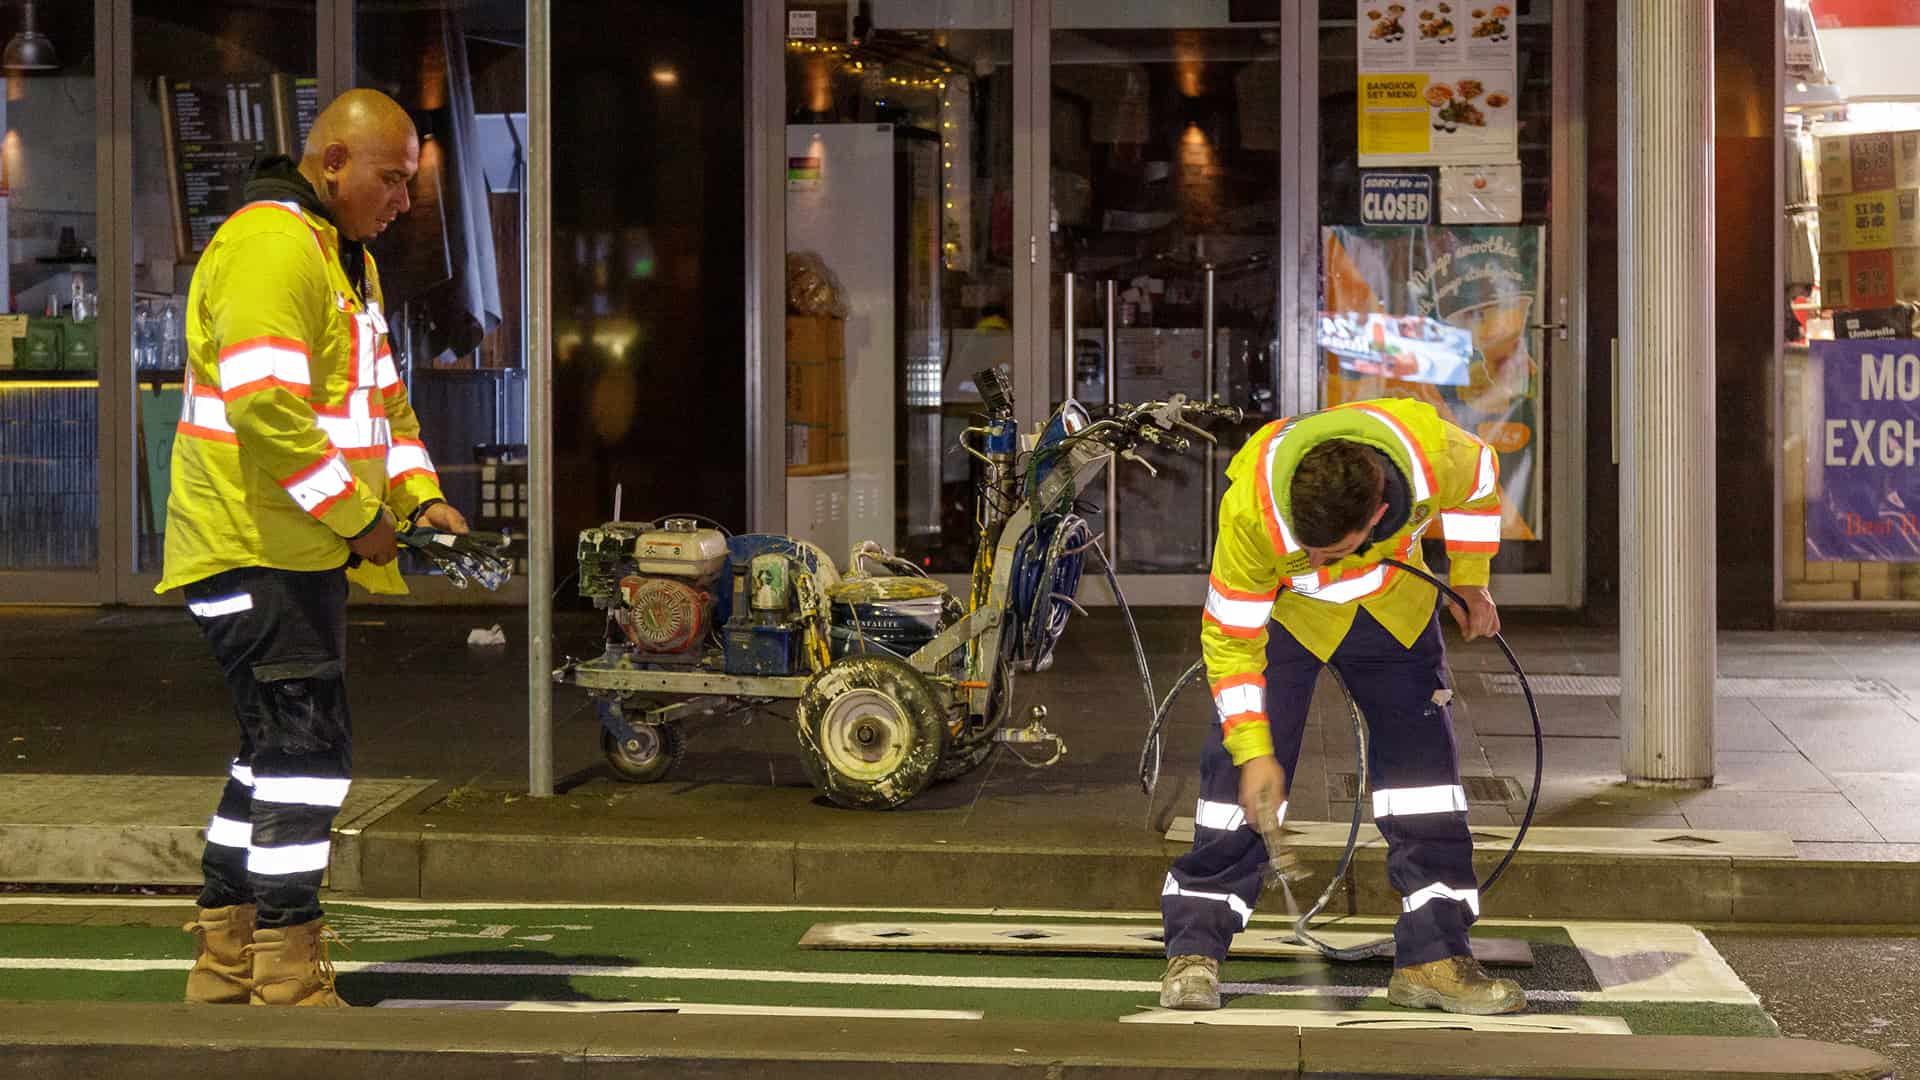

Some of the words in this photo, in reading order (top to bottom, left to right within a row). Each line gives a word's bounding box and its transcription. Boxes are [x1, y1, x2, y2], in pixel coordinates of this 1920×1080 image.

[1366, 82, 1417, 90] BANGKOK
[1366, 91, 1384, 99] SET
[1387, 91, 1417, 99] MENU
[1364, 192, 1428, 221] CLOSED
[1456, 235, 1521, 258] smoothie
[1848, 326, 1897, 339] Umbrella
[1860, 353, 1920, 401] MO
